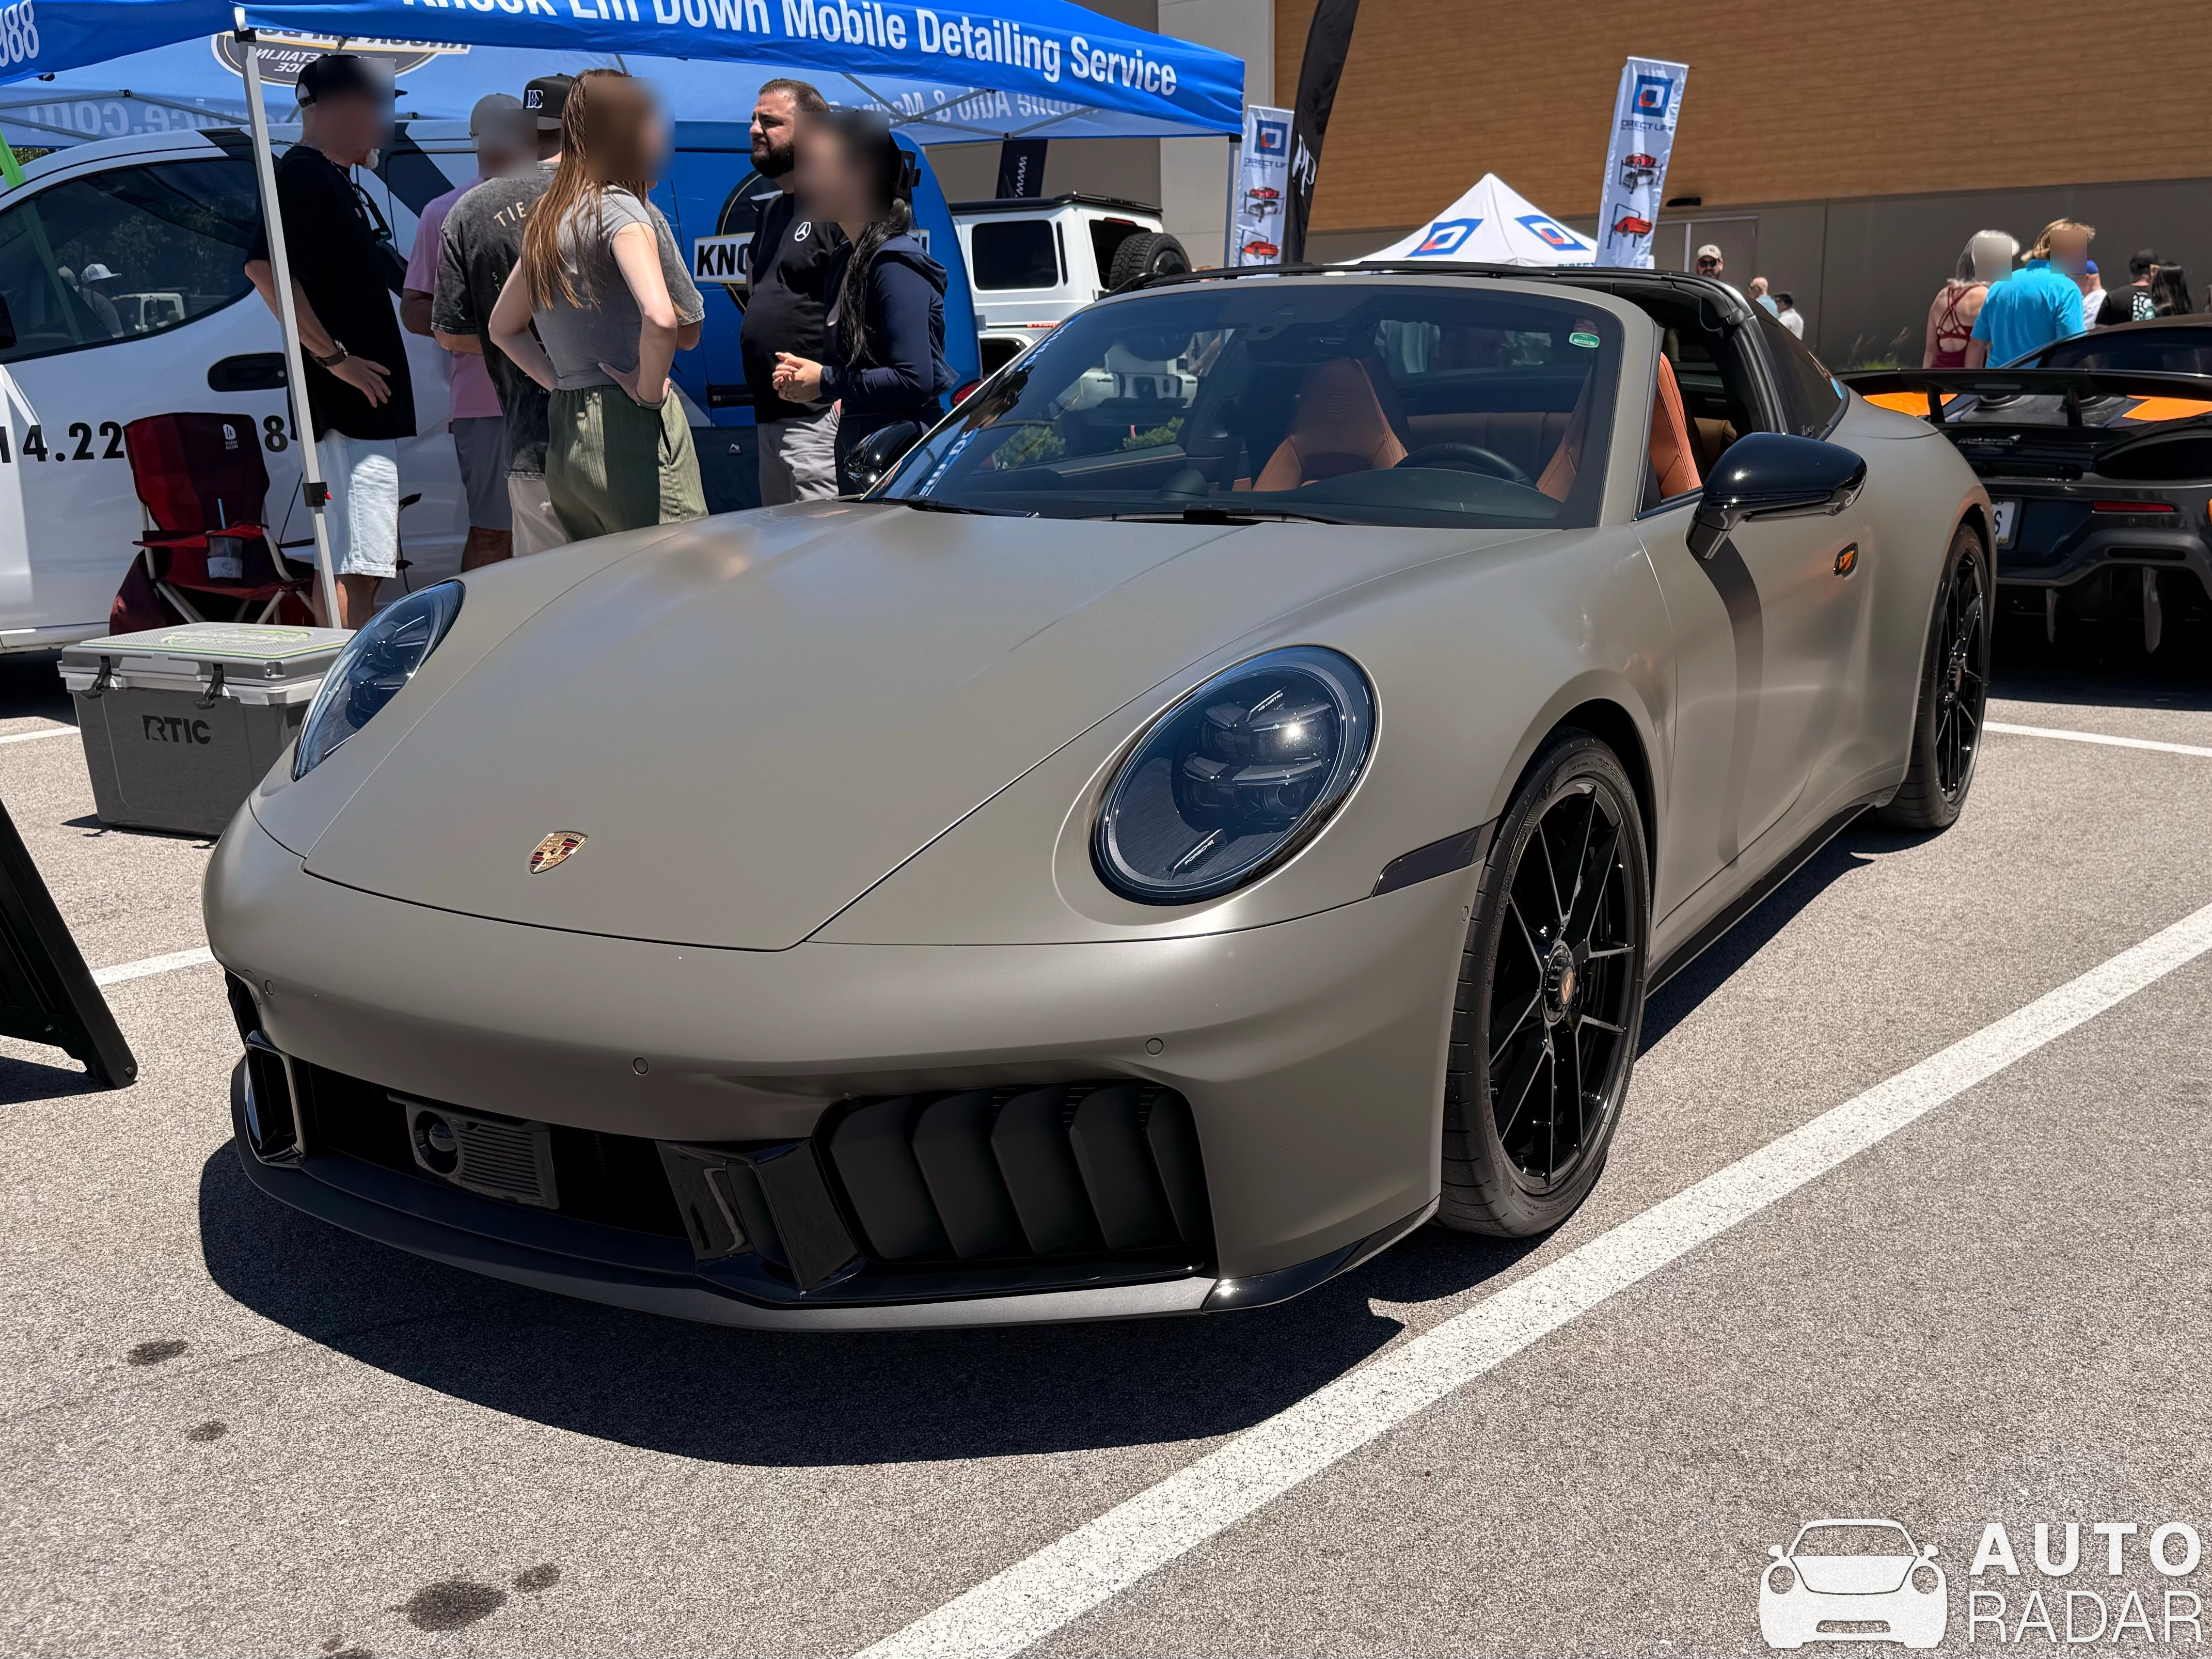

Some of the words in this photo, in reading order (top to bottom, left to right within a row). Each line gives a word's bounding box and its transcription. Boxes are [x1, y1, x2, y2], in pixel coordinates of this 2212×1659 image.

[653, 0, 770, 34] Down
[779, 0, 907, 50] Mobile
[915, 9, 1060, 83] Detailing
[1070, 36, 1177, 96] Service
[142, 715, 211, 745] RTIC
